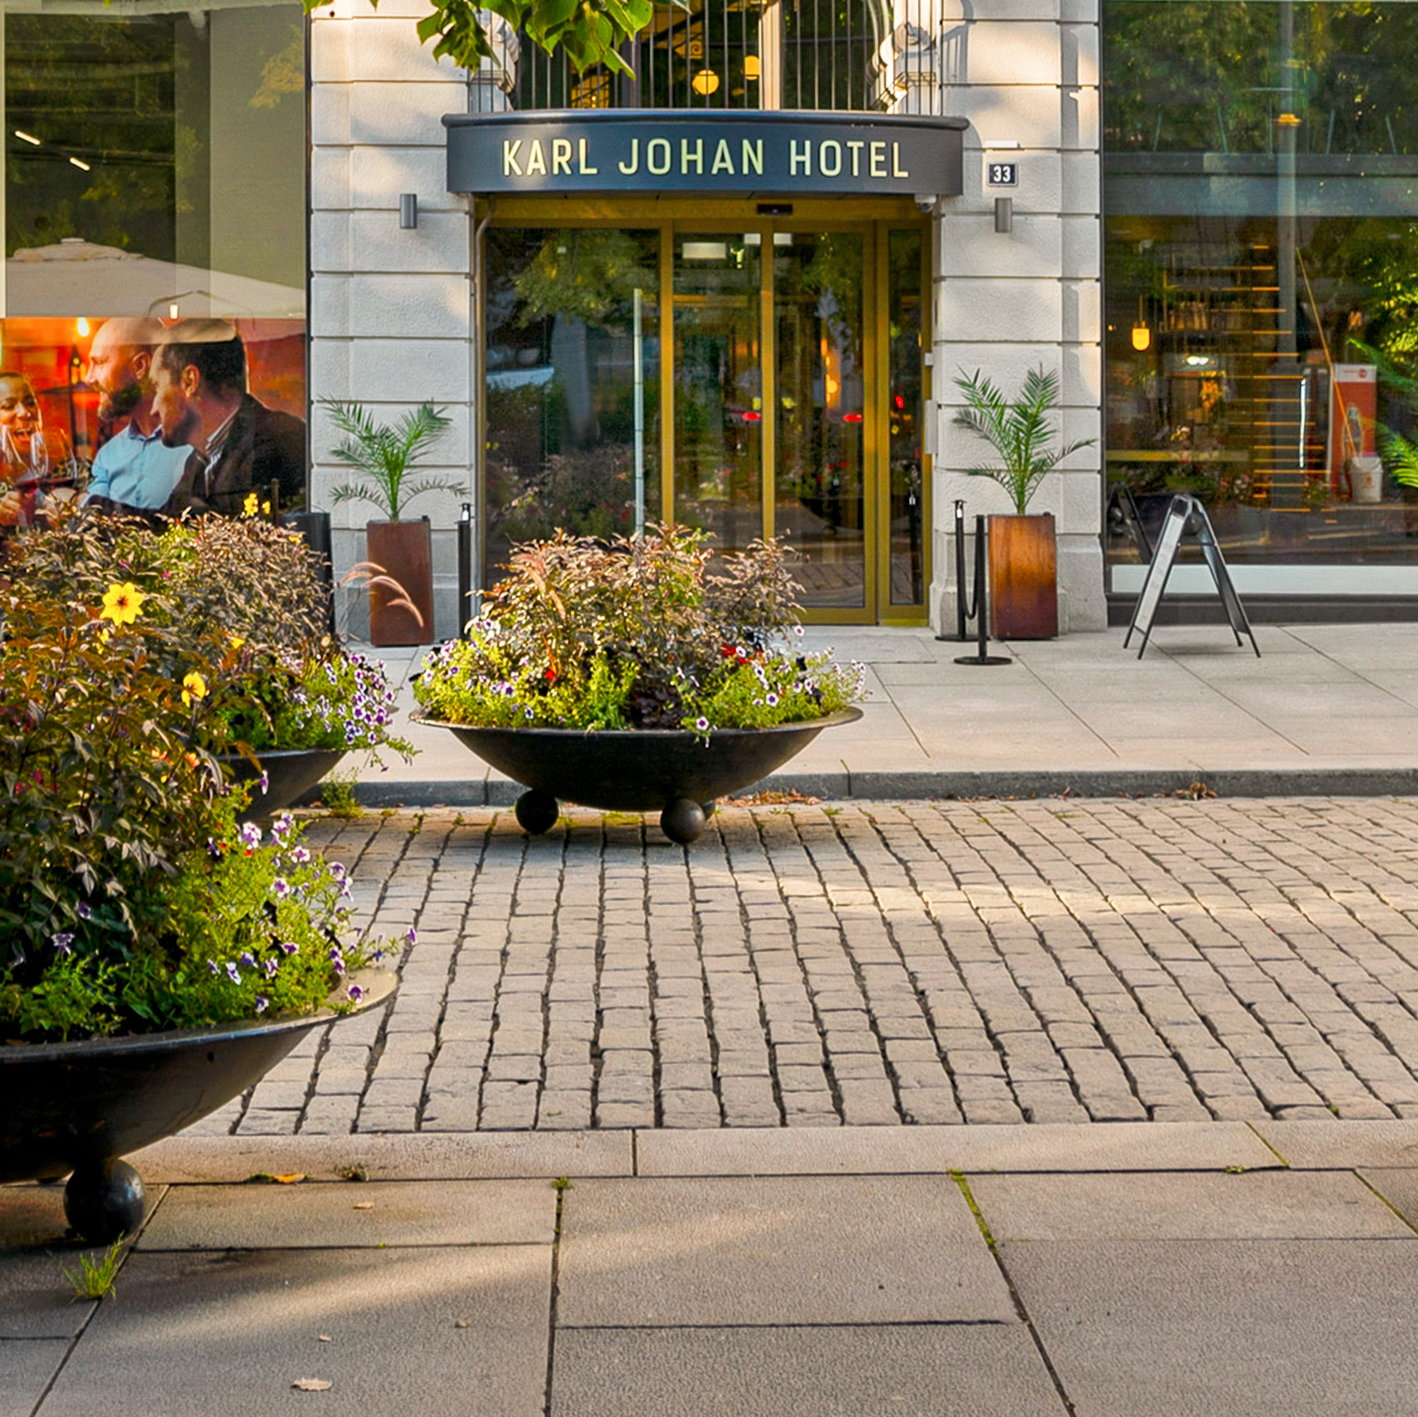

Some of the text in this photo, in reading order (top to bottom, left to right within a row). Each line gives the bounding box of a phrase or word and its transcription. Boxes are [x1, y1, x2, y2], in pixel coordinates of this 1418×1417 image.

[503, 138, 910, 178] KARL JOHAN HOTEL
[993, 165, 1011, 182] 33
